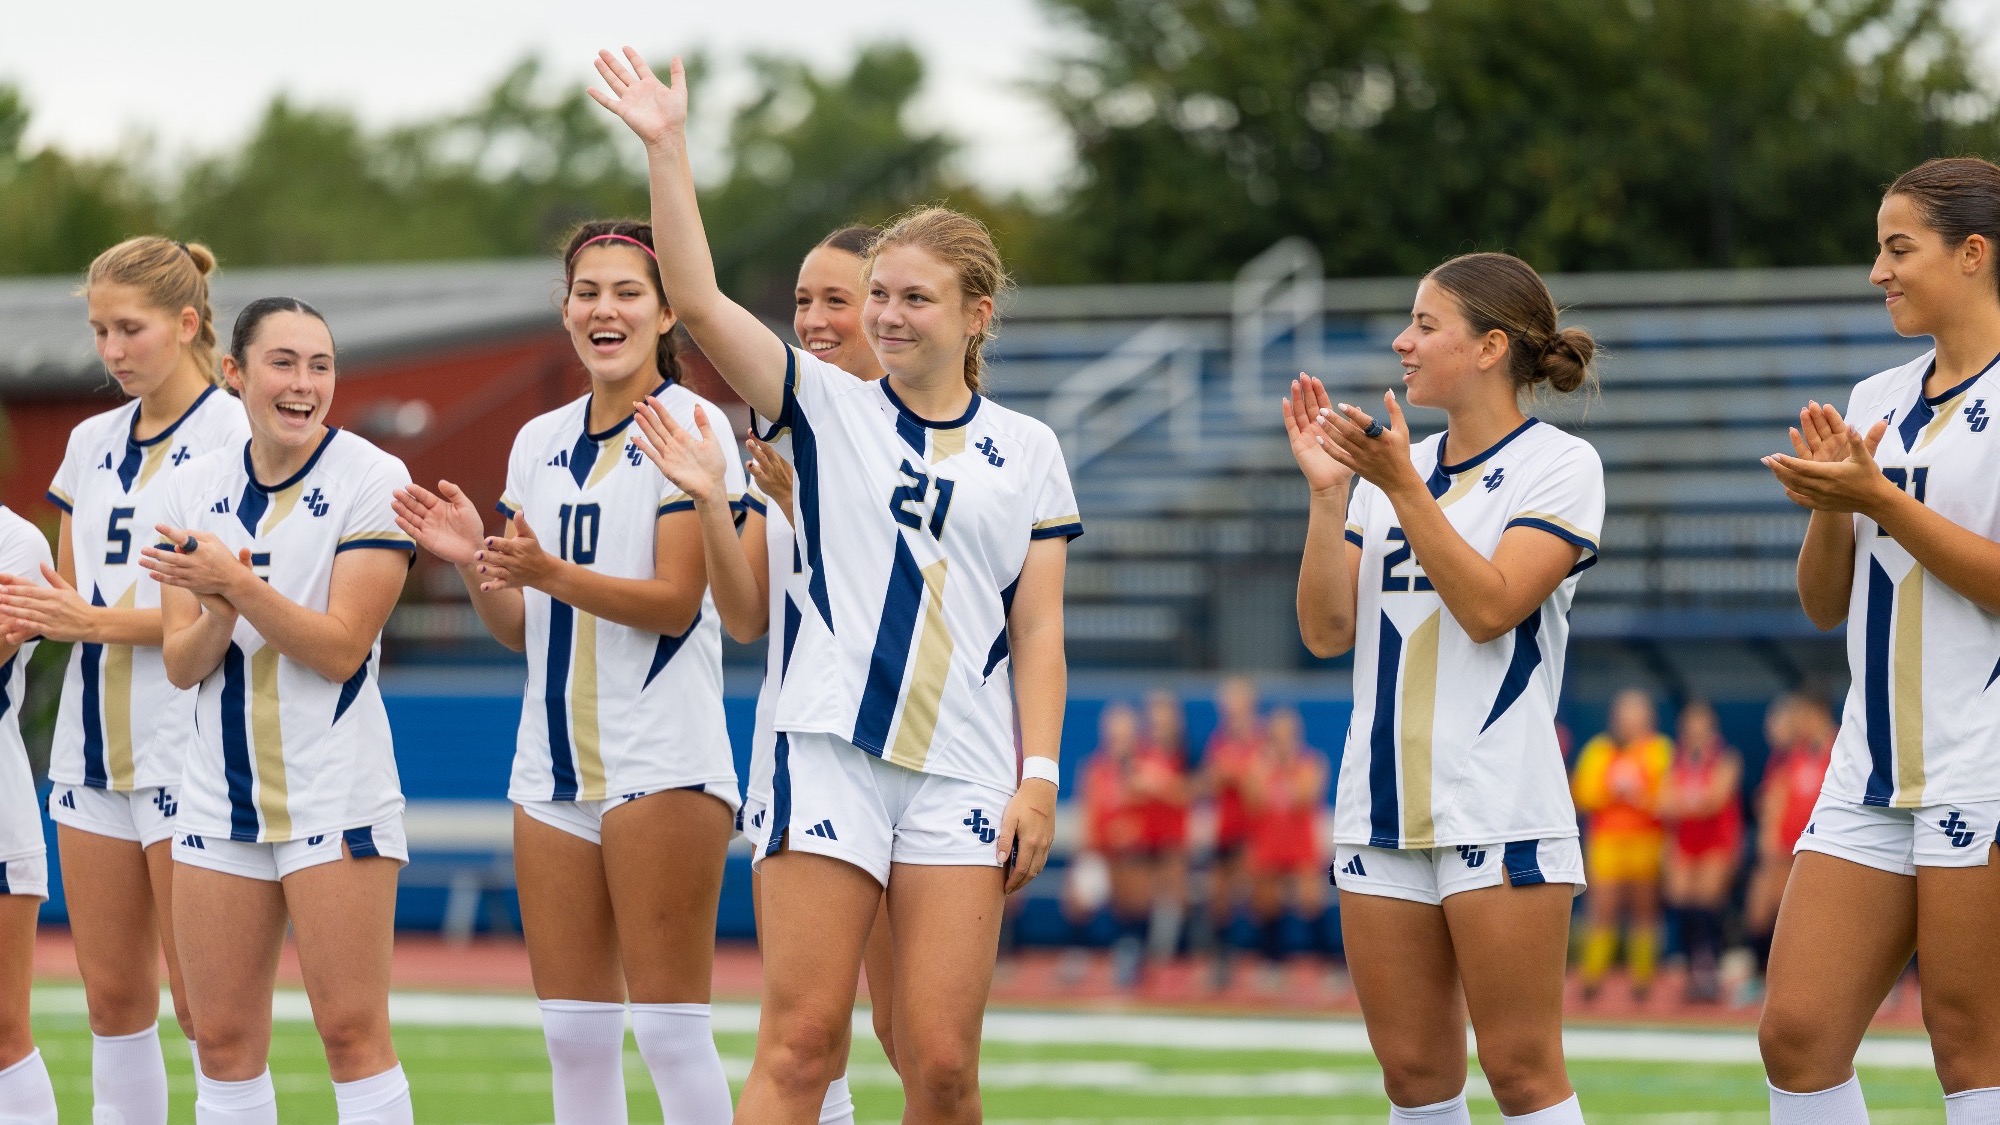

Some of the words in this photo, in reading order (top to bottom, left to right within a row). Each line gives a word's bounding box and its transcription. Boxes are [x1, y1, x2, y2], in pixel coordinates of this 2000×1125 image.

[1963, 399, 1990, 433] JCU
[974, 436, 1006, 468] JCU
[302, 487, 330, 517] JCU
[888, 458, 955, 541] 21
[104, 506, 136, 566] 5
[558, 502, 602, 565] 10
[962, 808, 996, 844] JCU
[1938, 811, 1976, 849] JCU
